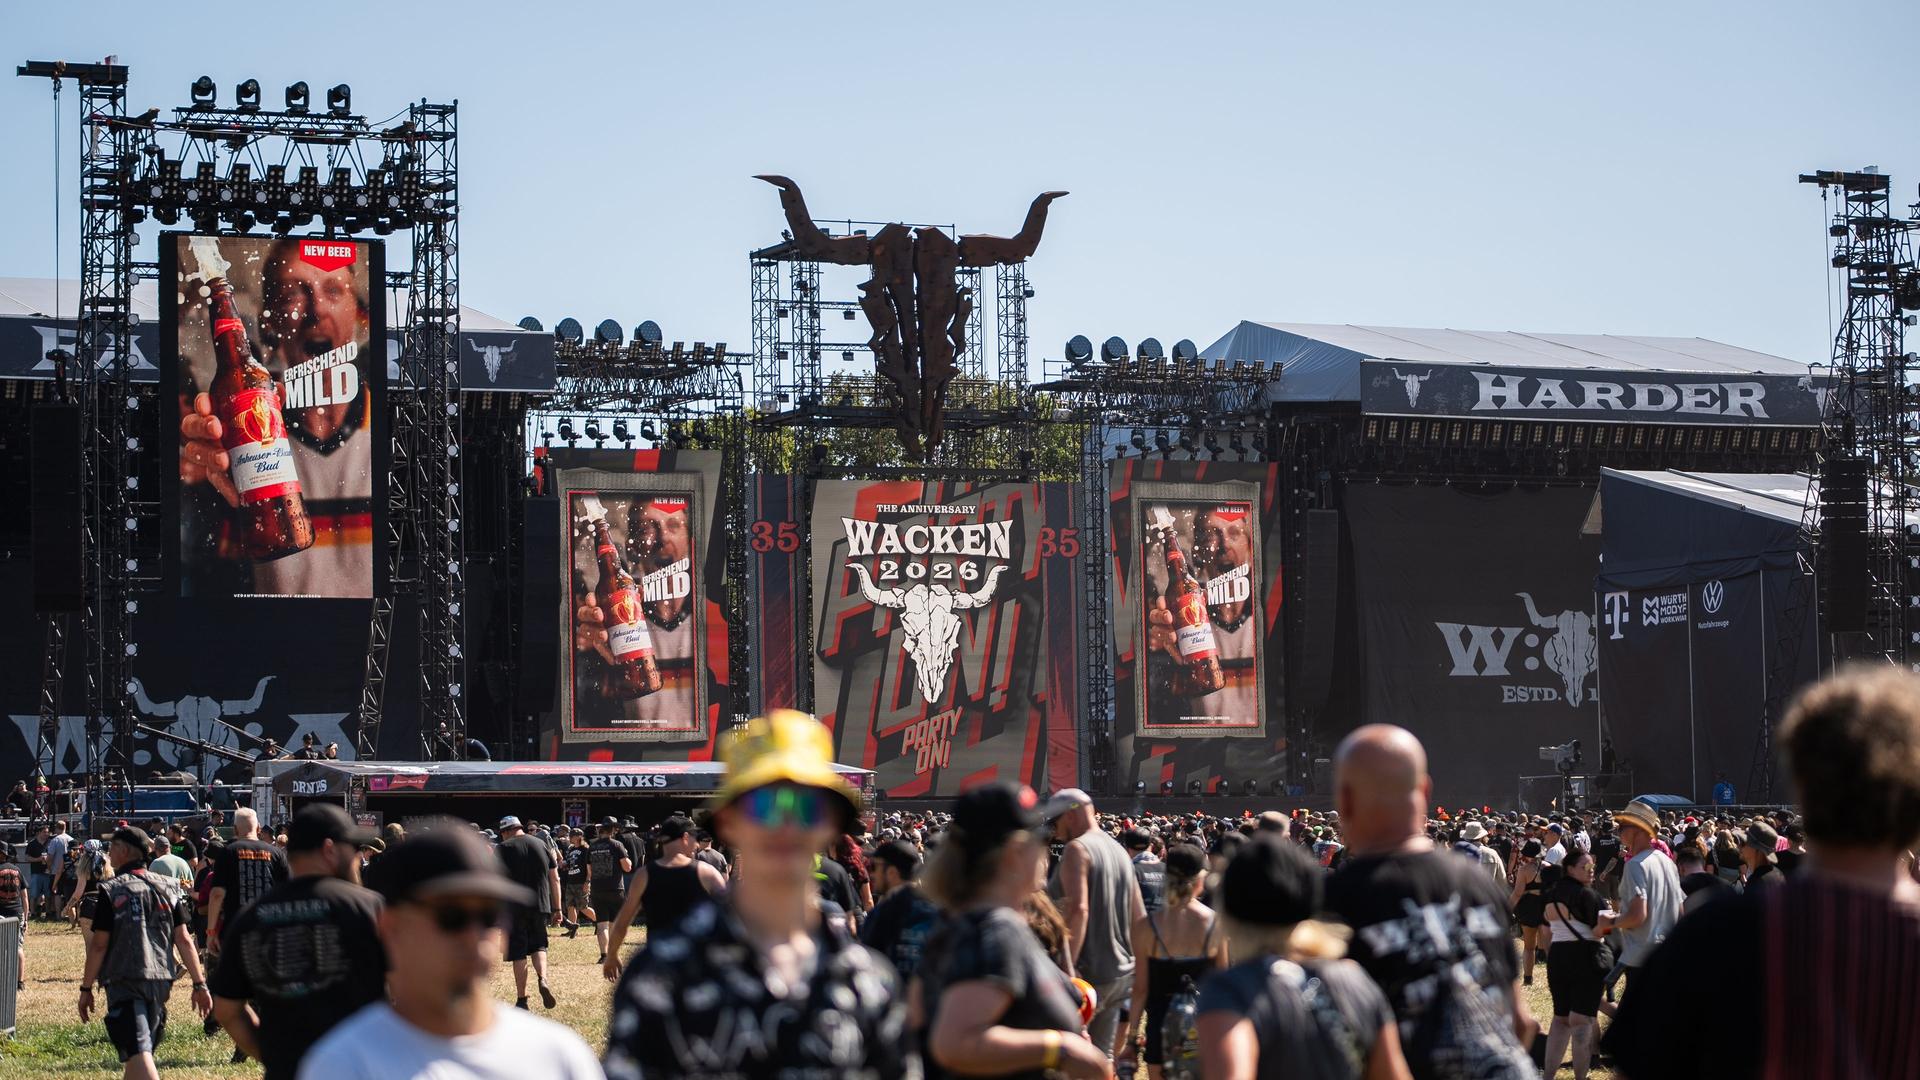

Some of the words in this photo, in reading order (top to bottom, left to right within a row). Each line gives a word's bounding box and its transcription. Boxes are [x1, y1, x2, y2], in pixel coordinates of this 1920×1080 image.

[304, 245, 325, 256] NEW
[327, 246, 351, 258] BEER
[284, 341, 358, 381] ERFRISCHEND
[285, 363, 359, 409] MILD
[1470, 371, 1770, 418] HARDER
[254, 461, 280, 473] Bud
[876, 504, 898, 514] THE
[900, 504, 976, 514] ANNIVERSARY
[751, 520, 800, 552] 35
[841, 516, 1014, 559] WACKEN
[879, 560, 980, 580] 2026
[643, 571, 691, 602] MILD
[1207, 576, 1251, 606] MILD
[1660, 593, 1687, 606] WÜRTH
[1660, 604, 1687, 616] MODYF
[1501, 685, 1562, 703] ESTD.
[901, 706, 965, 757] PARTY
[914, 740, 952, 776] ON!
[571, 775, 668, 788] DRINKS
